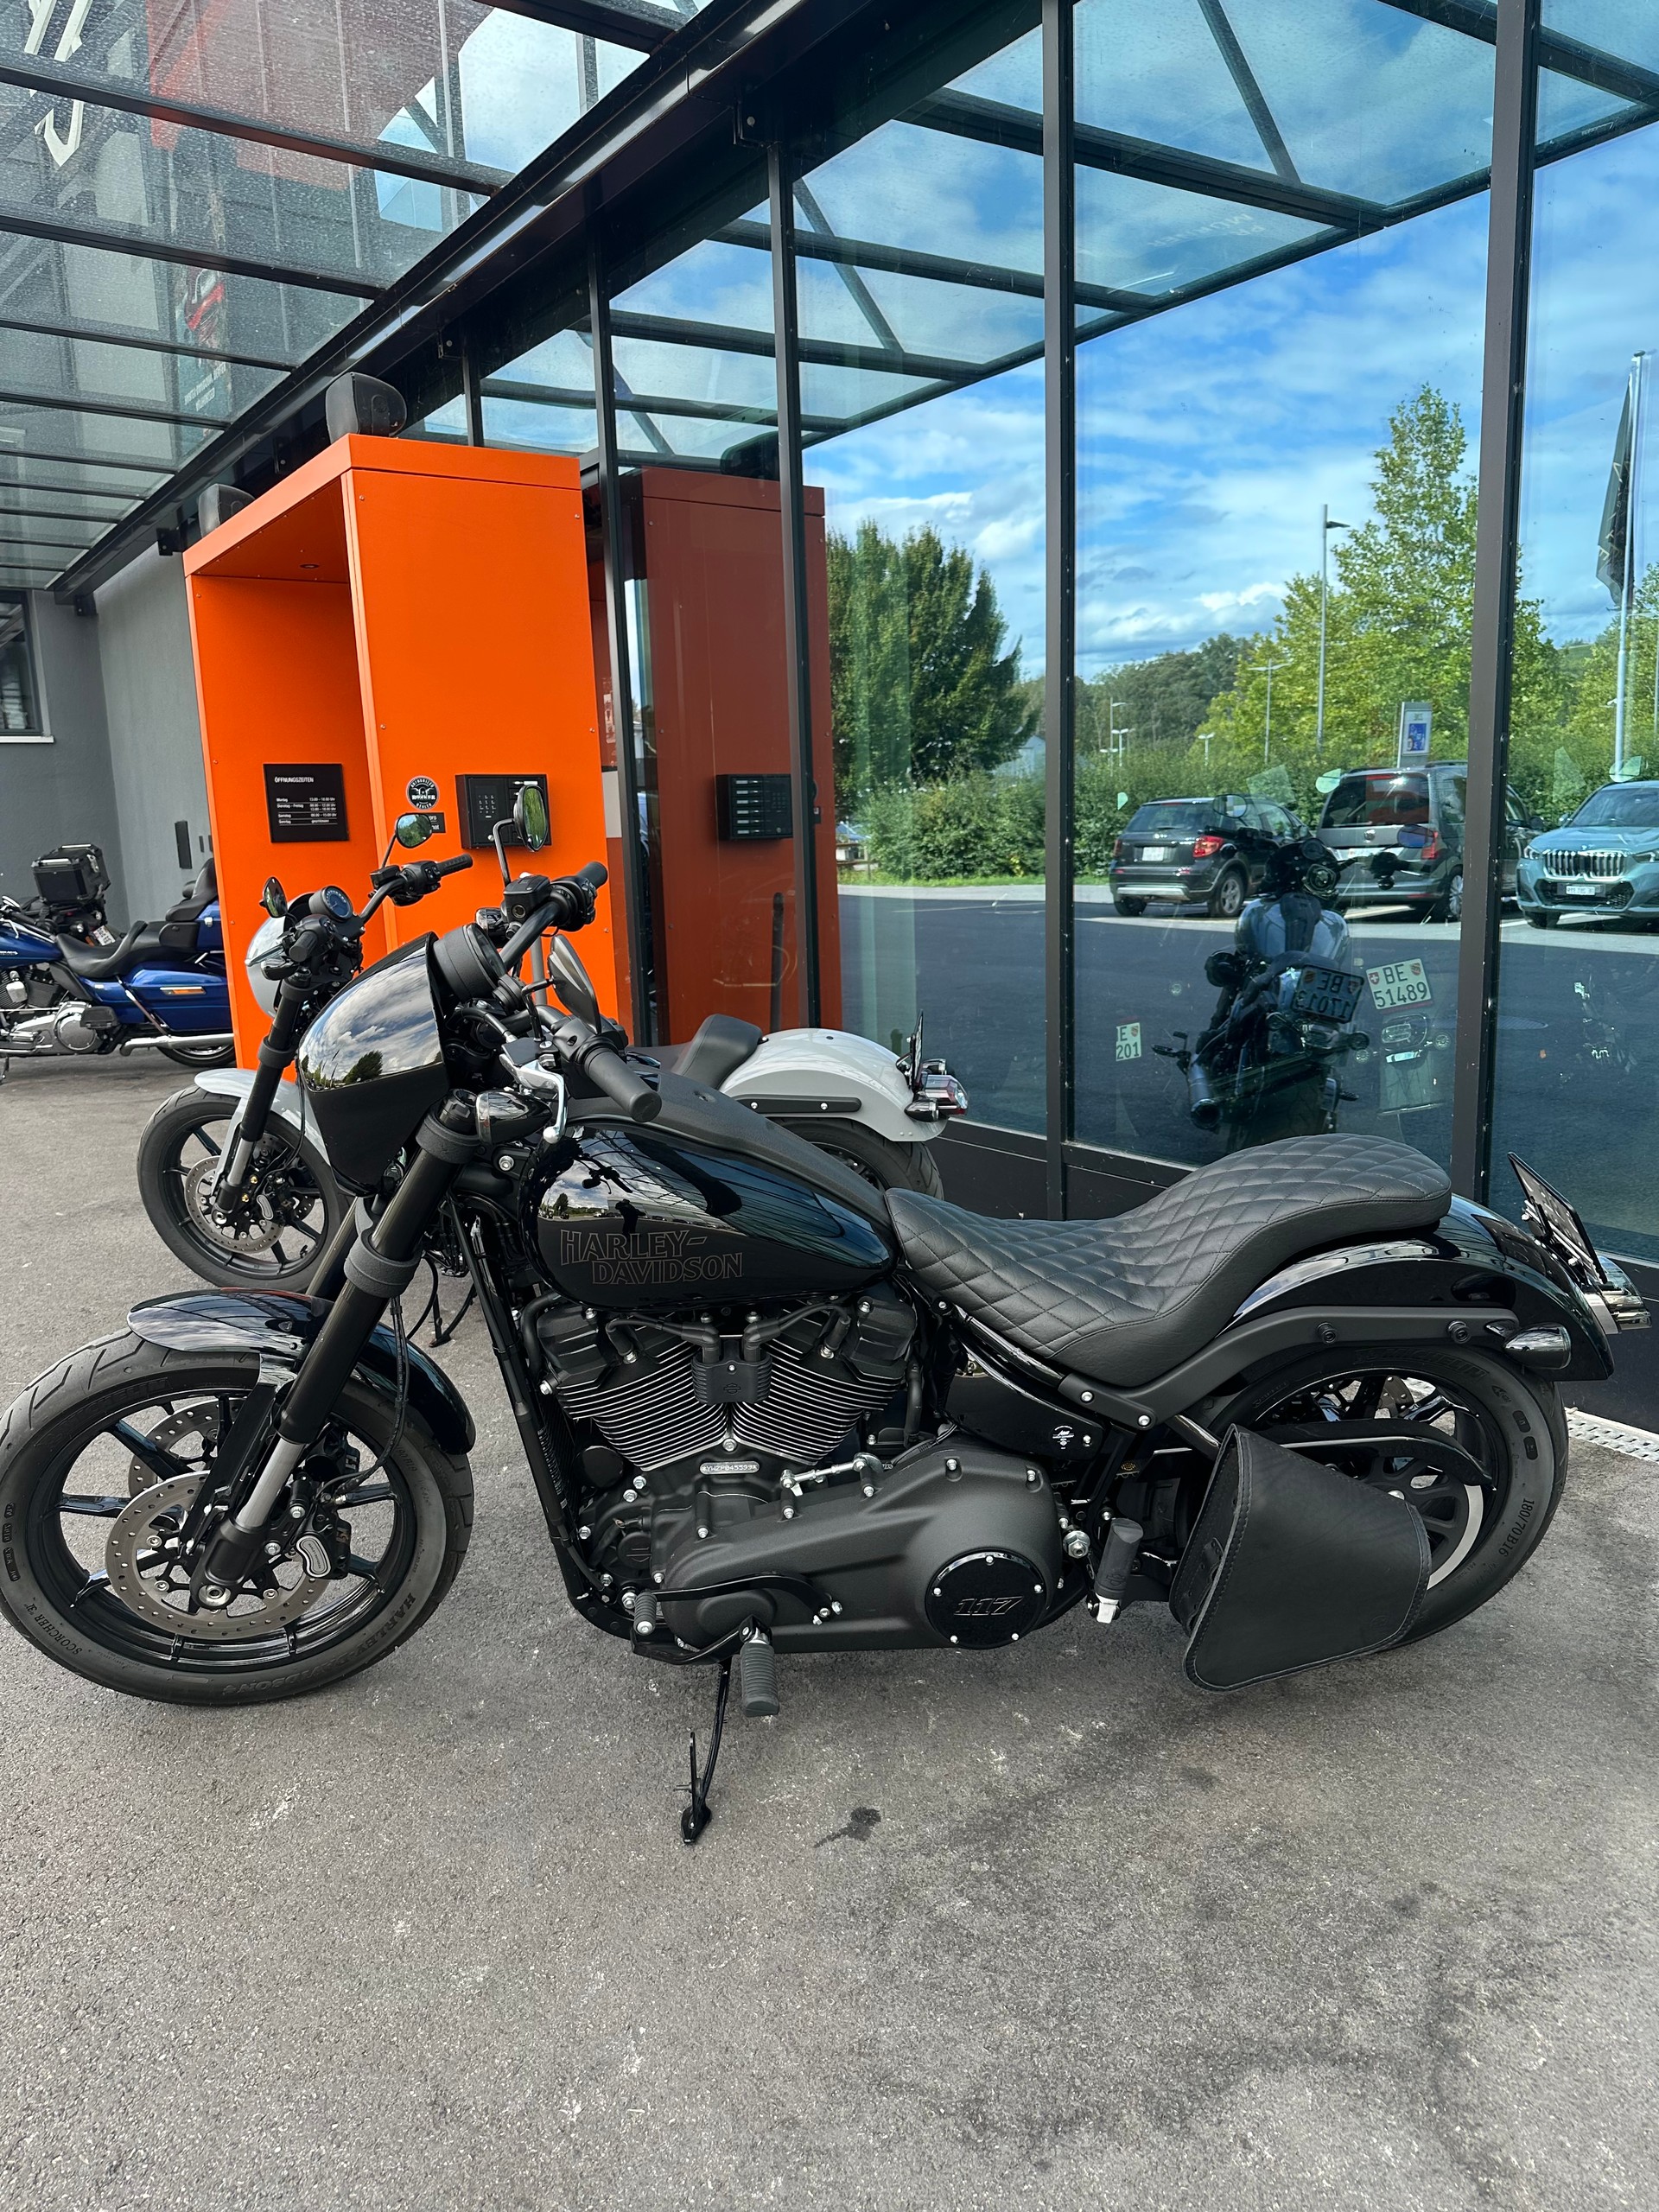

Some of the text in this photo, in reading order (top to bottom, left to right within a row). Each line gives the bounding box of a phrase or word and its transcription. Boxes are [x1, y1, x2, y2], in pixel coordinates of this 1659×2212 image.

[1382, 963, 1408, 984] BE
[1373, 982, 1427, 1007] 51489
[561, 1229, 707, 1266] HARLEY-
[592, 1252, 744, 1285] DAVIDSON
[953, 1596, 1024, 1616] 117
[34, 1613, 83, 1655] SCORCHER
